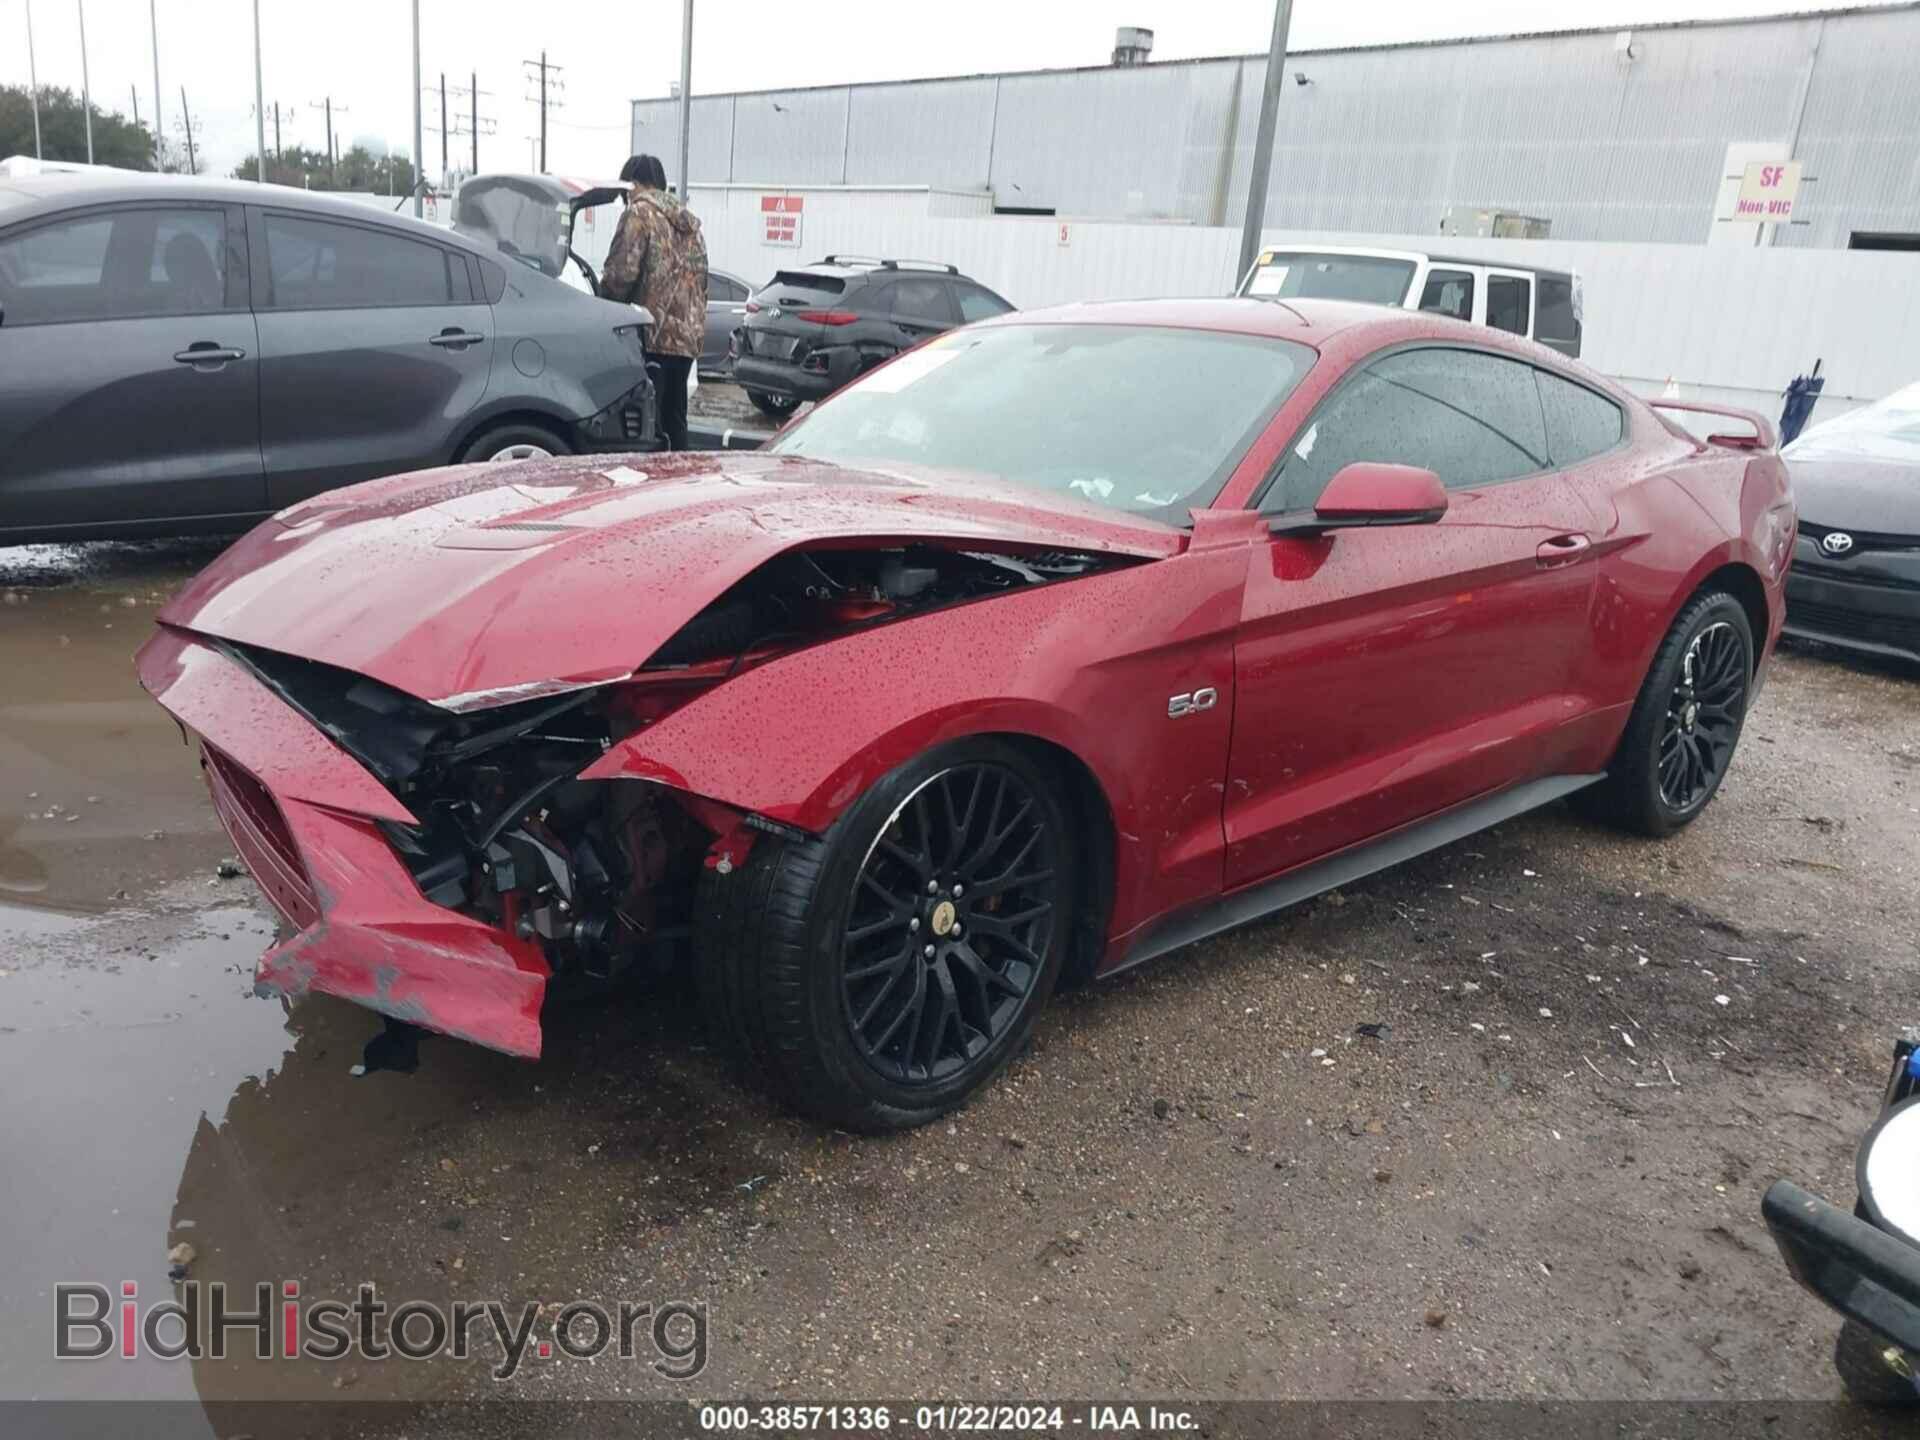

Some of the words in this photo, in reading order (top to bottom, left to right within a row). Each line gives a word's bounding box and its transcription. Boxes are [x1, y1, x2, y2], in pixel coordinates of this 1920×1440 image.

[1760, 166, 1784, 187] SF
[1738, 199, 1791, 215] Non-VIC
[1168, 687, 1217, 719] 5.0
